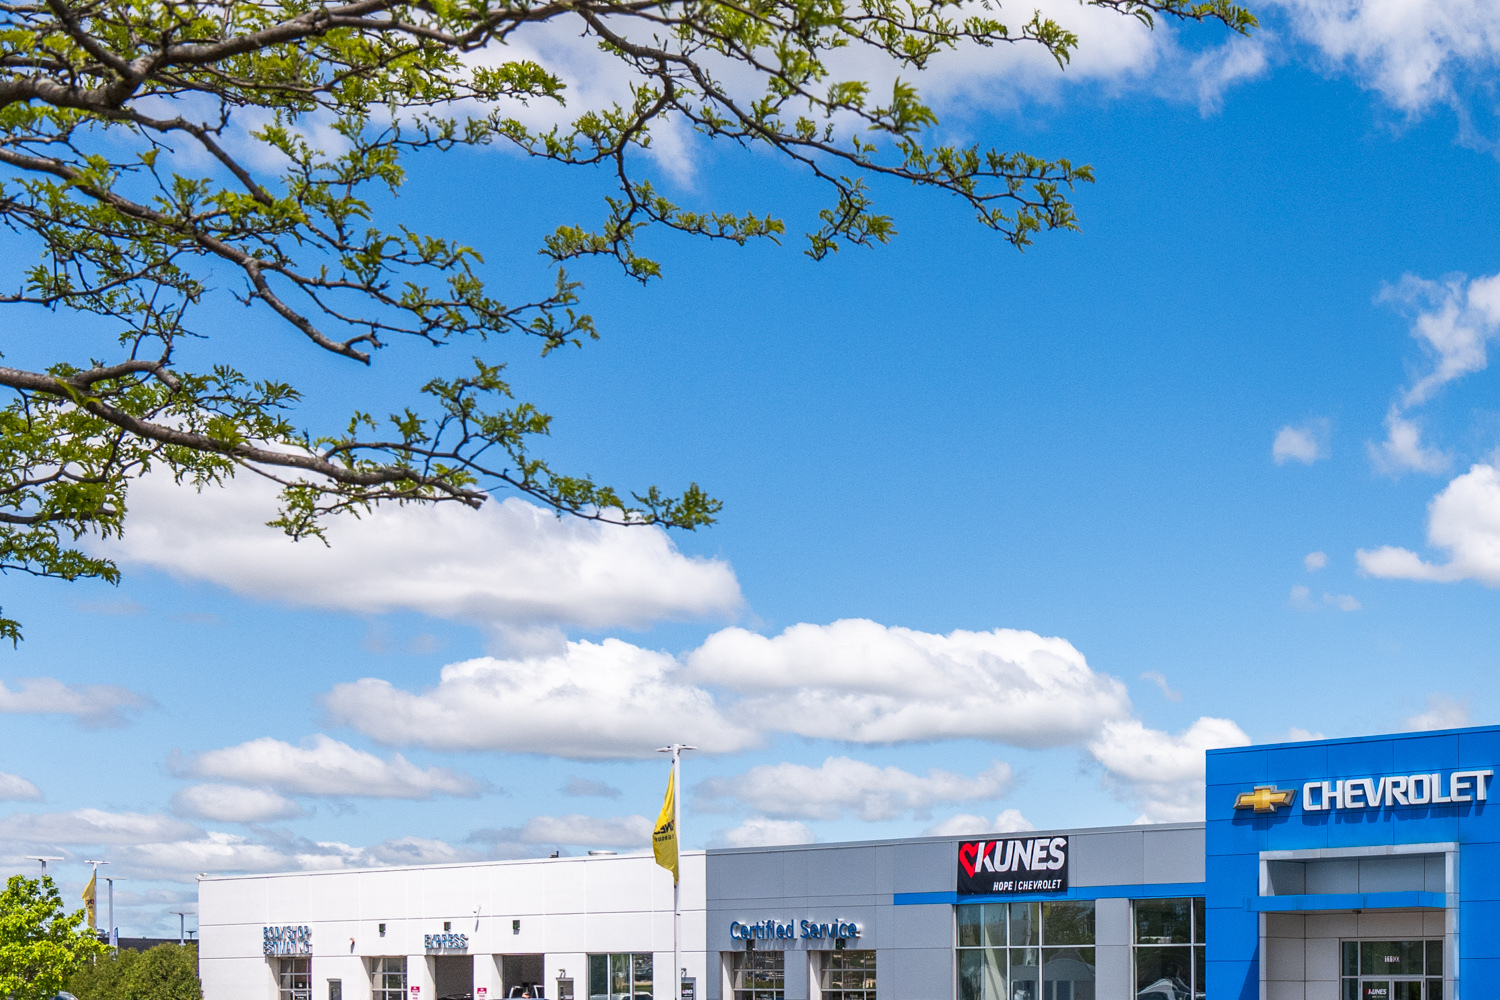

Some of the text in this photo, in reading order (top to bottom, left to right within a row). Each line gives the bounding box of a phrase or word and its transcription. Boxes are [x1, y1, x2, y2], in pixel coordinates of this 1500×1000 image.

[1302, 769, 1494, 812] CHEVROLET
[974, 838, 1067, 873] KUNES
[993, 881, 1014, 892] HOPE
[1018, 879, 1062, 890] CHEVROLET
[730, 918, 858, 940] Certified Service
[424, 934, 467, 948] EXPRESS
